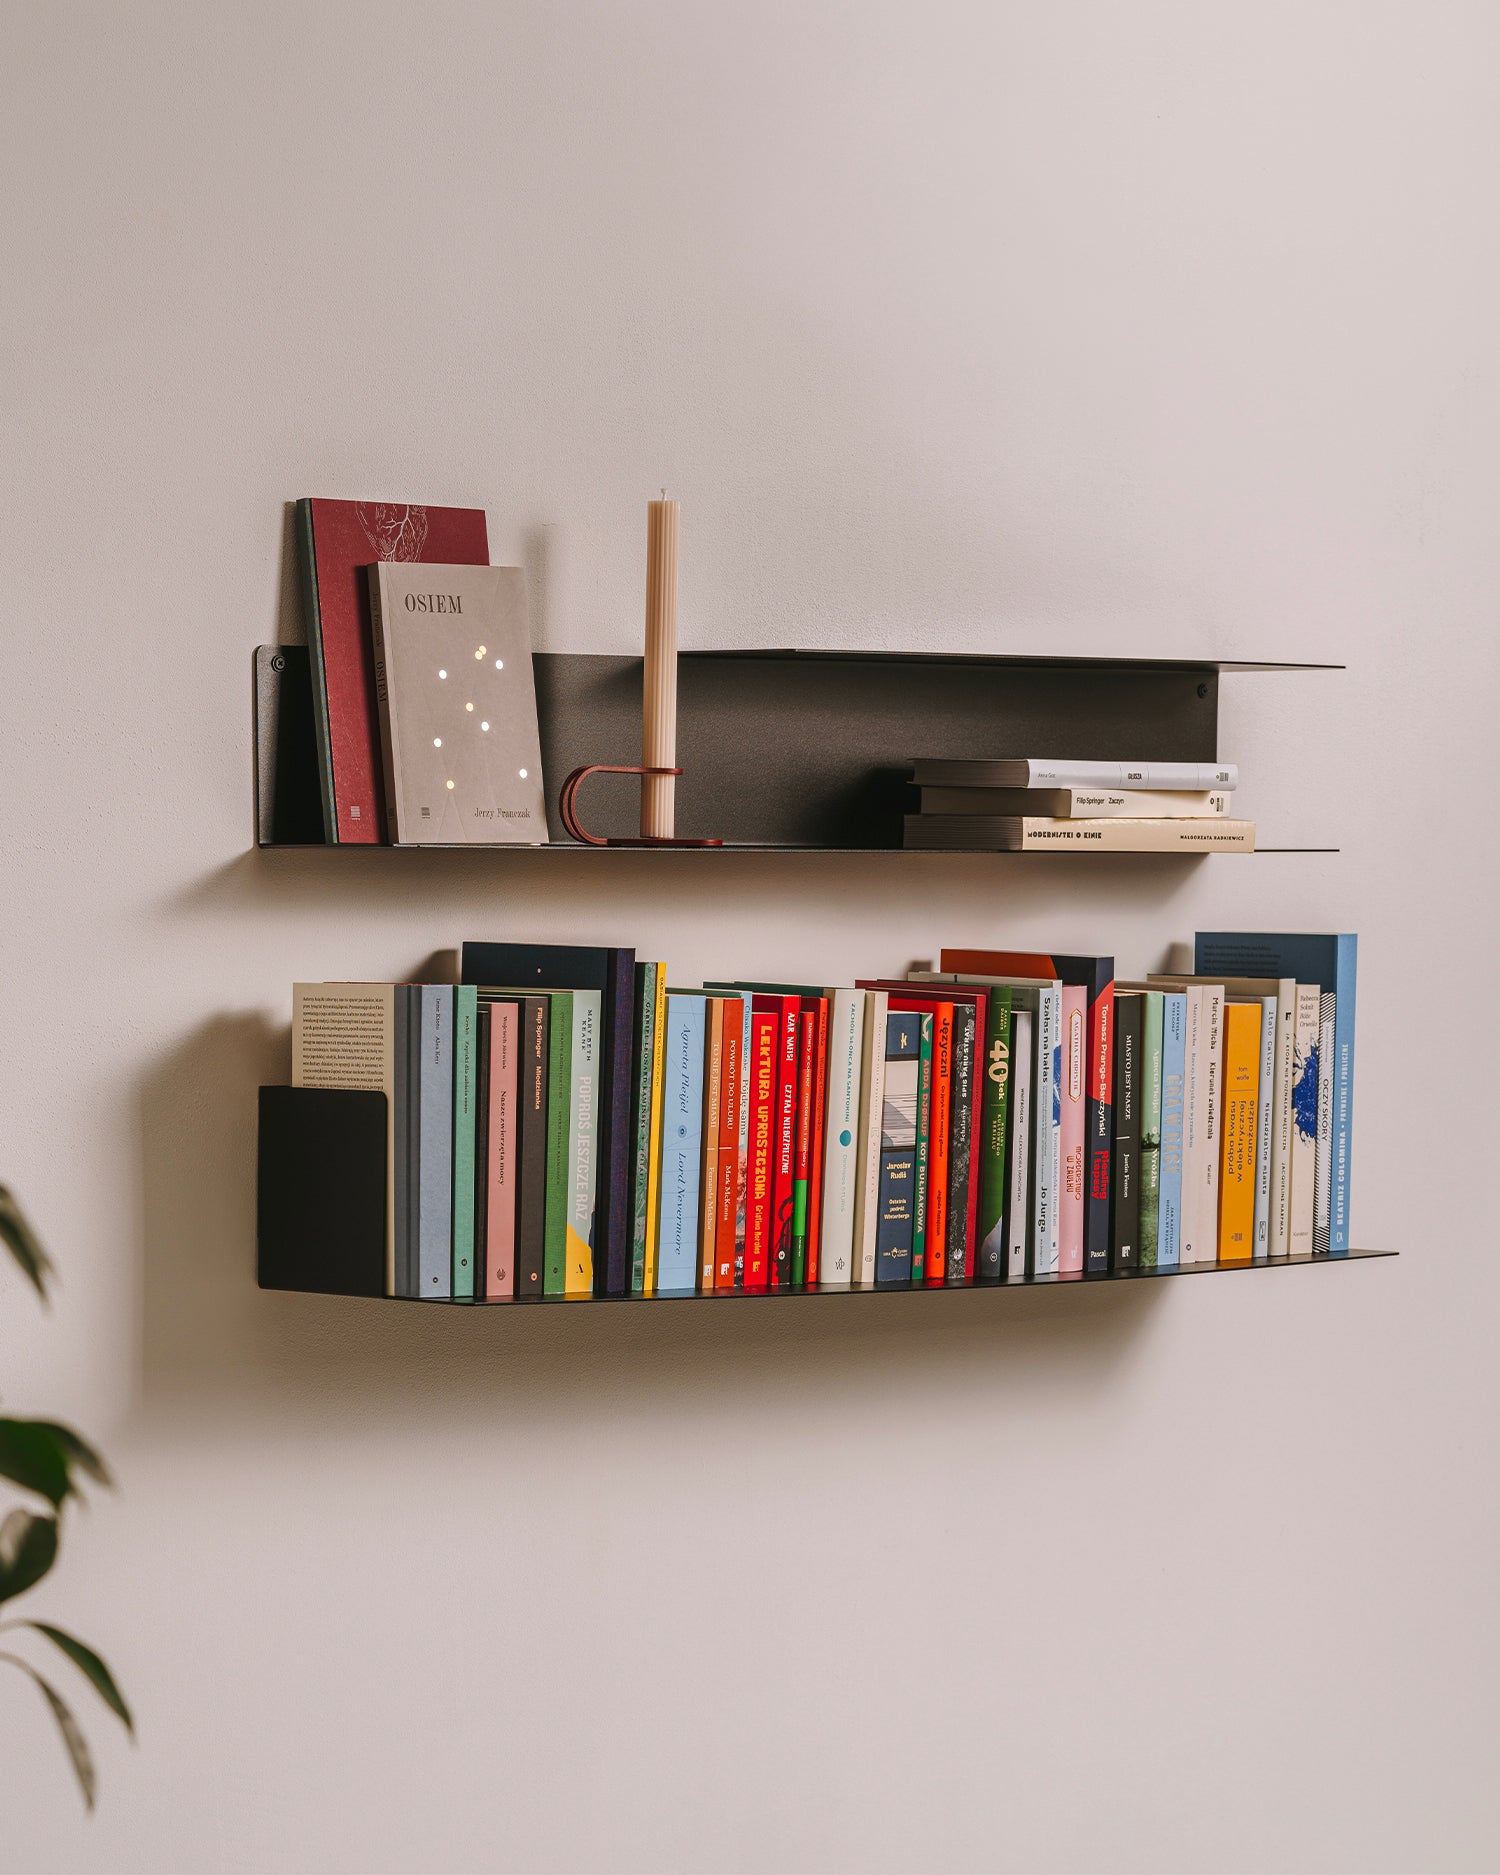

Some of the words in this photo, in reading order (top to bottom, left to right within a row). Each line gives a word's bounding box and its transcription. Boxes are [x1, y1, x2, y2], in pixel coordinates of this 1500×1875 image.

[404, 593, 463, 614] OSIEM
[474, 807, 495, 820] Jerzy
[497, 807, 531, 819] Franczak
[1076, 797, 1086, 805] Filip
[1086, 797, 1105, 805] Springer
[1108, 797, 1125, 805] Zaczyn
[787, 1012, 795, 1033] AZAR
[1042, 997, 1050, 1034] Szałas
[1101, 1004, 1109, 1042] Tomasz
[1211, 998, 1219, 1025] Marcin
[535, 1025, 543, 1058] Springer
[680, 1024, 690, 1069] Agneta
[713, 1043, 719, 1056] TO
[786, 1037, 794, 1061] NAFISI
[938, 1018, 950, 1078] Języczni
[1043, 1036, 1049, 1049] na
[1210, 1027, 1218, 1050] Wicha
[759, 1026, 772, 1100] LEKTURA
[847, 1068, 852, 1079] NA
[1042, 1052, 1050, 1083] hałas
[578, 1076, 592, 1129] POPROŚ
[679, 1073, 689, 1113] Pleijel
[728, 1082, 734, 1096] DO
[740, 1079, 749, 1107] Pójdę
[783, 1084, 792, 1114] CZYTAJ
[1098, 1044, 1107, 1136] Prange-Barczyński
[1164, 1074, 1182, 1107] GRA
[1164, 1113, 1181, 1125] W
[1228, 1101, 1236, 1136] kwasu
[1247, 1100, 1255, 1165] oranżadzie
[1262, 1102, 1270, 1161] Niewidzialne
[781, 1117, 791, 1174] NIEBEZPIECZNIE
[1237, 1100, 1246, 1170] elektrycznej
[576, 1133, 590, 1190] JESZCZE
[677, 1152, 686, 1182] Lord
[754, 1106, 769, 1199] UPROSZCZONA
[886, 1162, 911, 1170] Jaroslav
[1162, 1132, 1180, 1174] RASY
[1338, 1132, 1346, 1182] COLOMINA
[707, 1167, 715, 1199] Fernanda
[1092, 1158, 1100, 1199] tapasy
[1100, 1150, 1109, 1199] Riesling
[1237, 1173, 1242, 1182] w
[575, 1194, 588, 1220] RAZ
[917, 1166, 926, 1233] BUŁHAKOWA
[1040, 1186, 1047, 1200] Jo
[675, 1186, 685, 1255] Nevermore
[754, 1205, 764, 1230] Cristina
[1037, 1202, 1047, 1233] Jurga
[754, 1232, 763, 1254] Morales
[1090, 1249, 1106, 1258] Pascal
